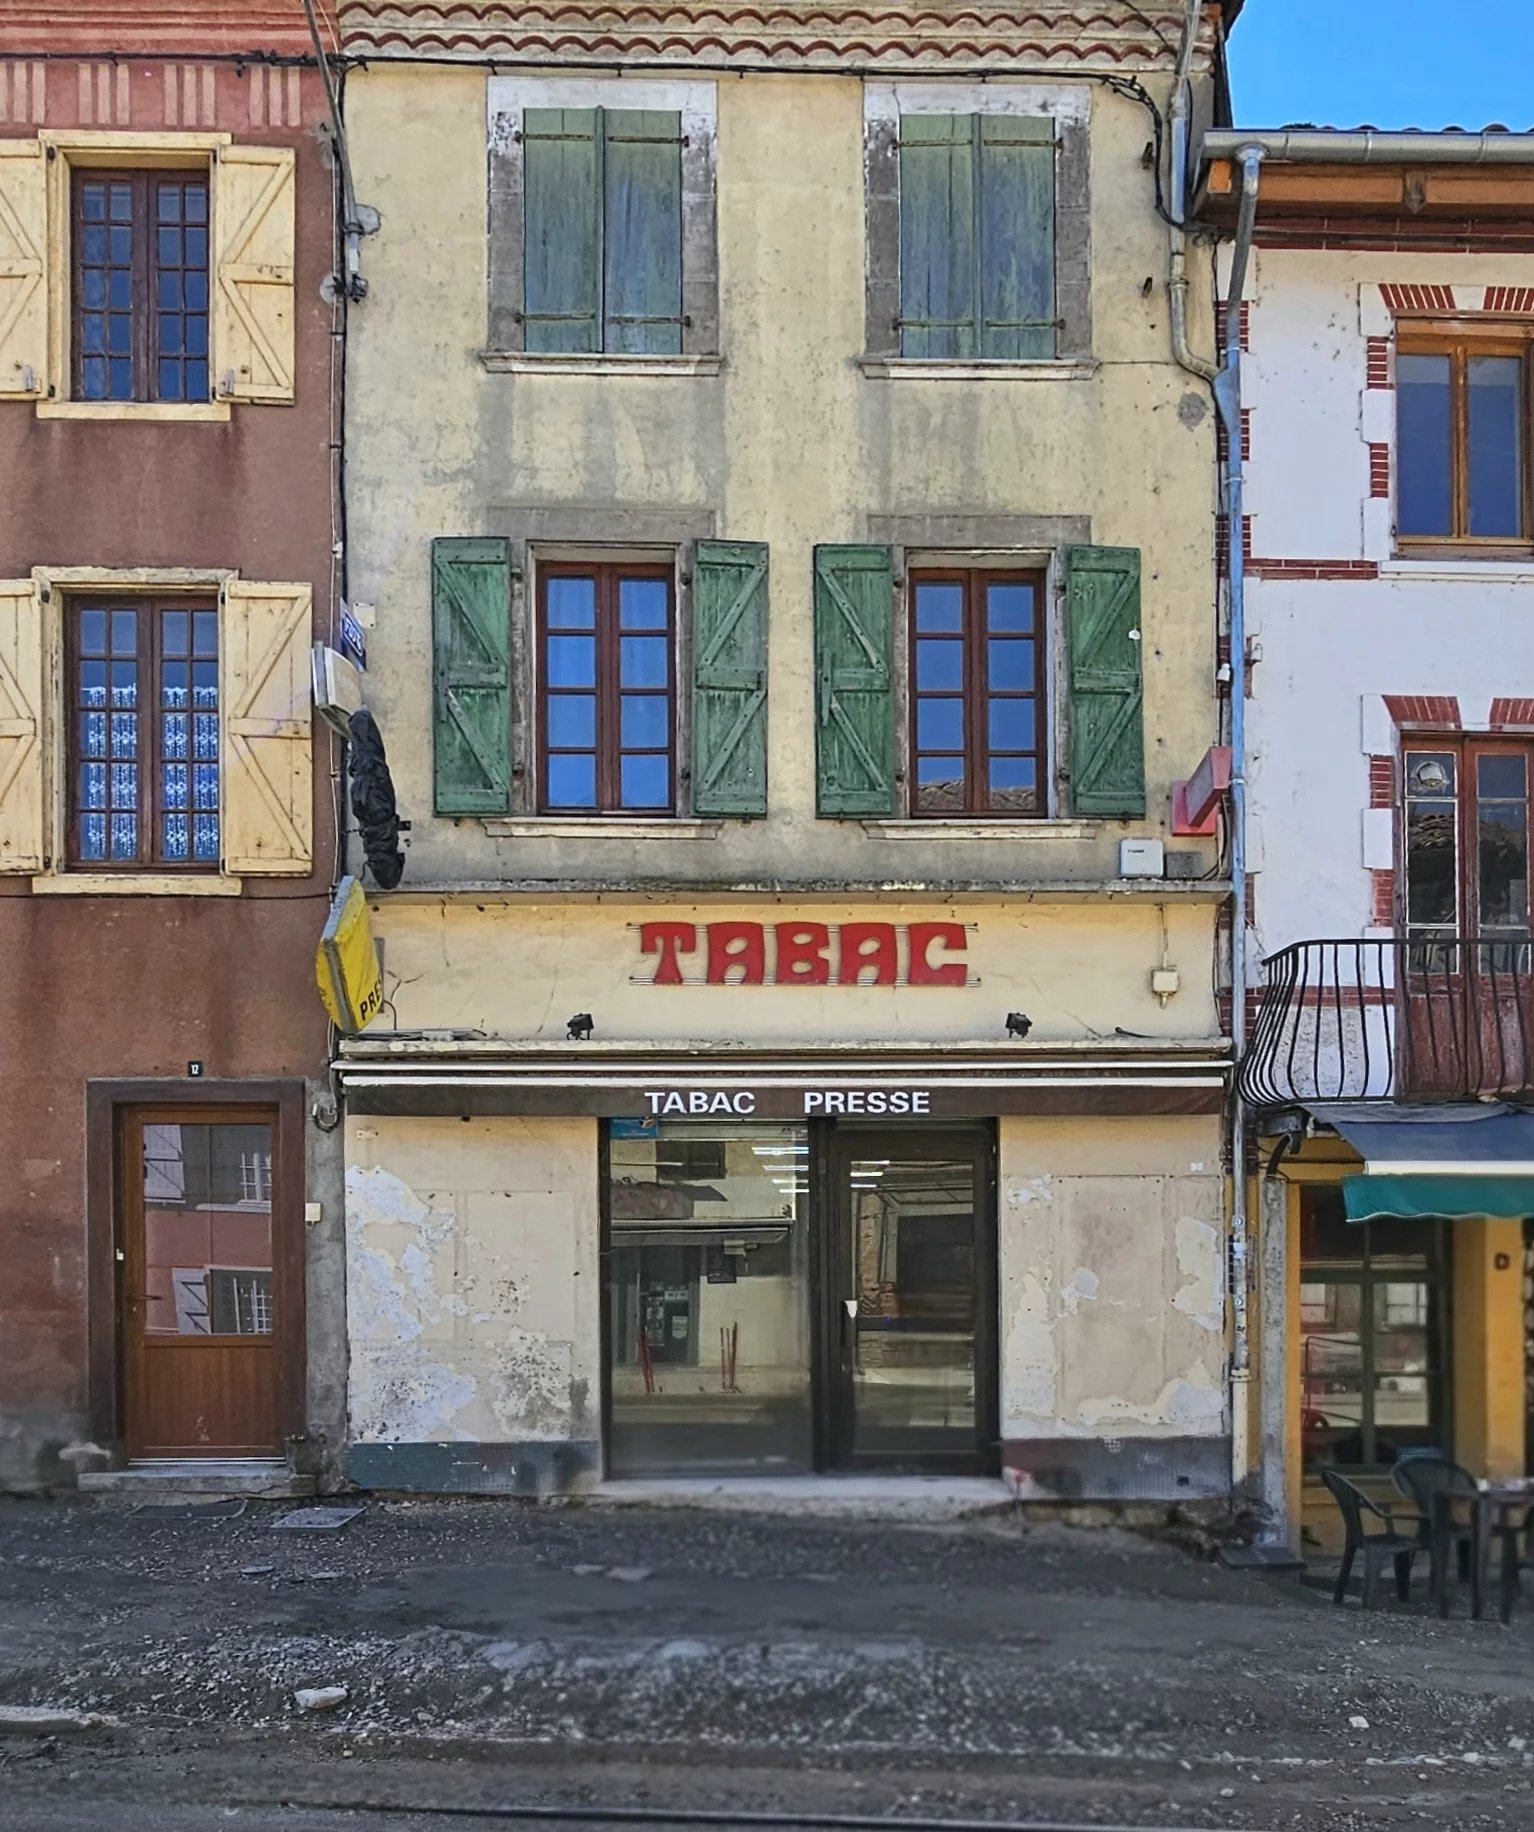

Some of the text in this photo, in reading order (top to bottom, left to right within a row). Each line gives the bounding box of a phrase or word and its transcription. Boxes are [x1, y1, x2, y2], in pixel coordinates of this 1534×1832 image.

[641, 921, 968, 987] TABAC
[190, 1064, 200, 1075] 12
[645, 1091, 931, 1114] TABAC PRESSE
